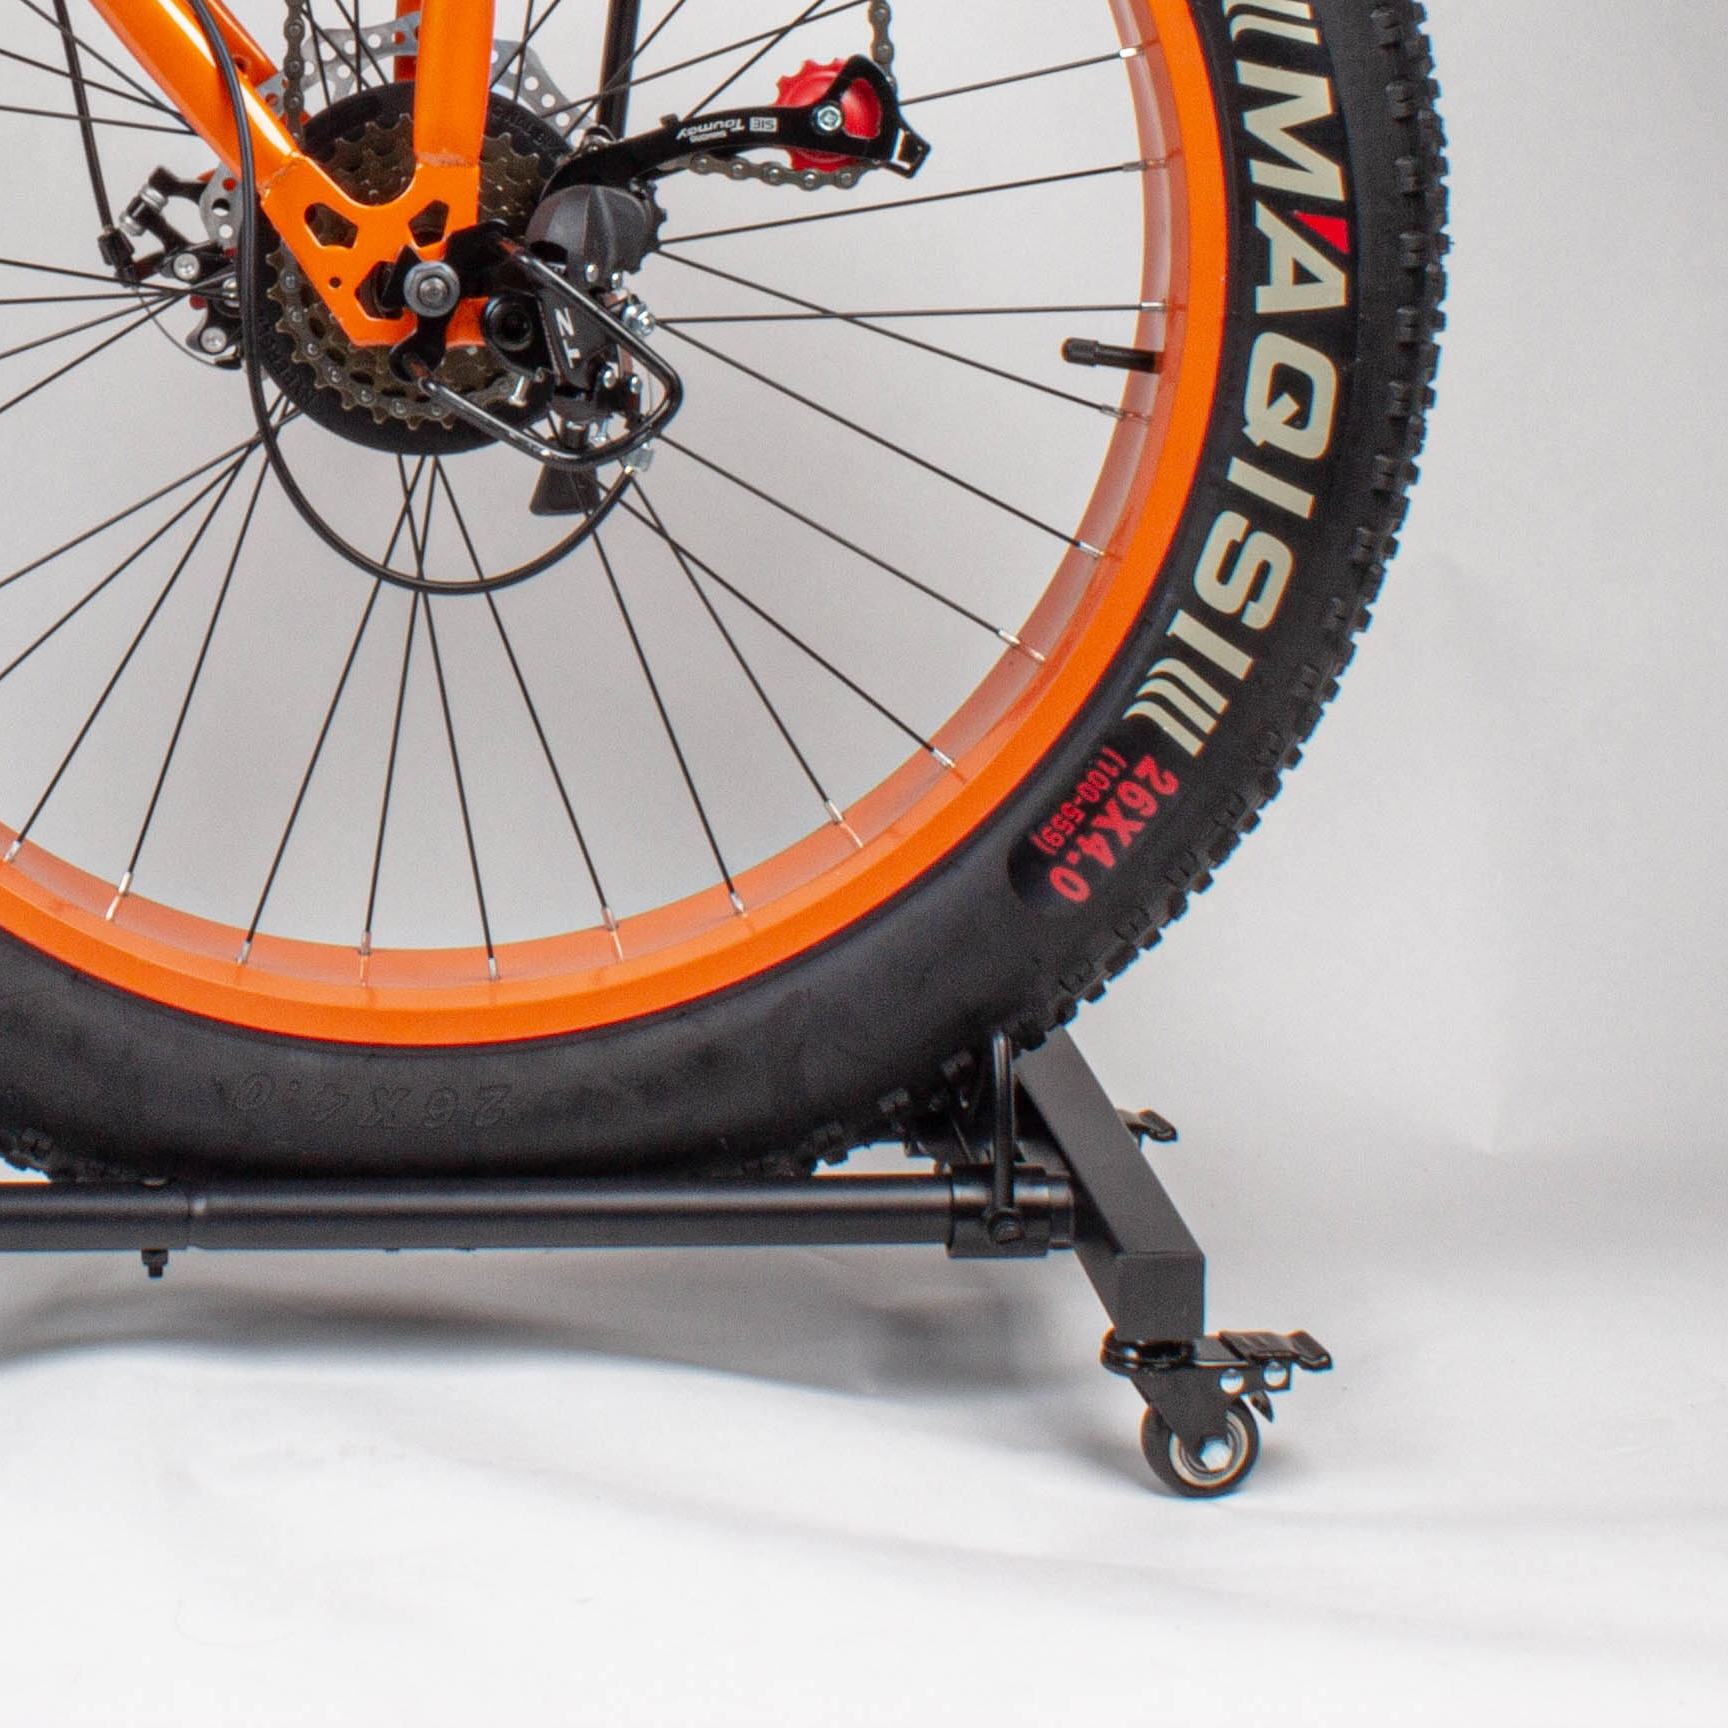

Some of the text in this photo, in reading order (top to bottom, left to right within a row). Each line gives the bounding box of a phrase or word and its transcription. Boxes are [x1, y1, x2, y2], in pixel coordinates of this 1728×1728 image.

[1167, 59, 1349, 681] MAQISI
[1033, 747, 1127, 855] (100-559)
[1050, 756, 1179, 901] 26X4.0
